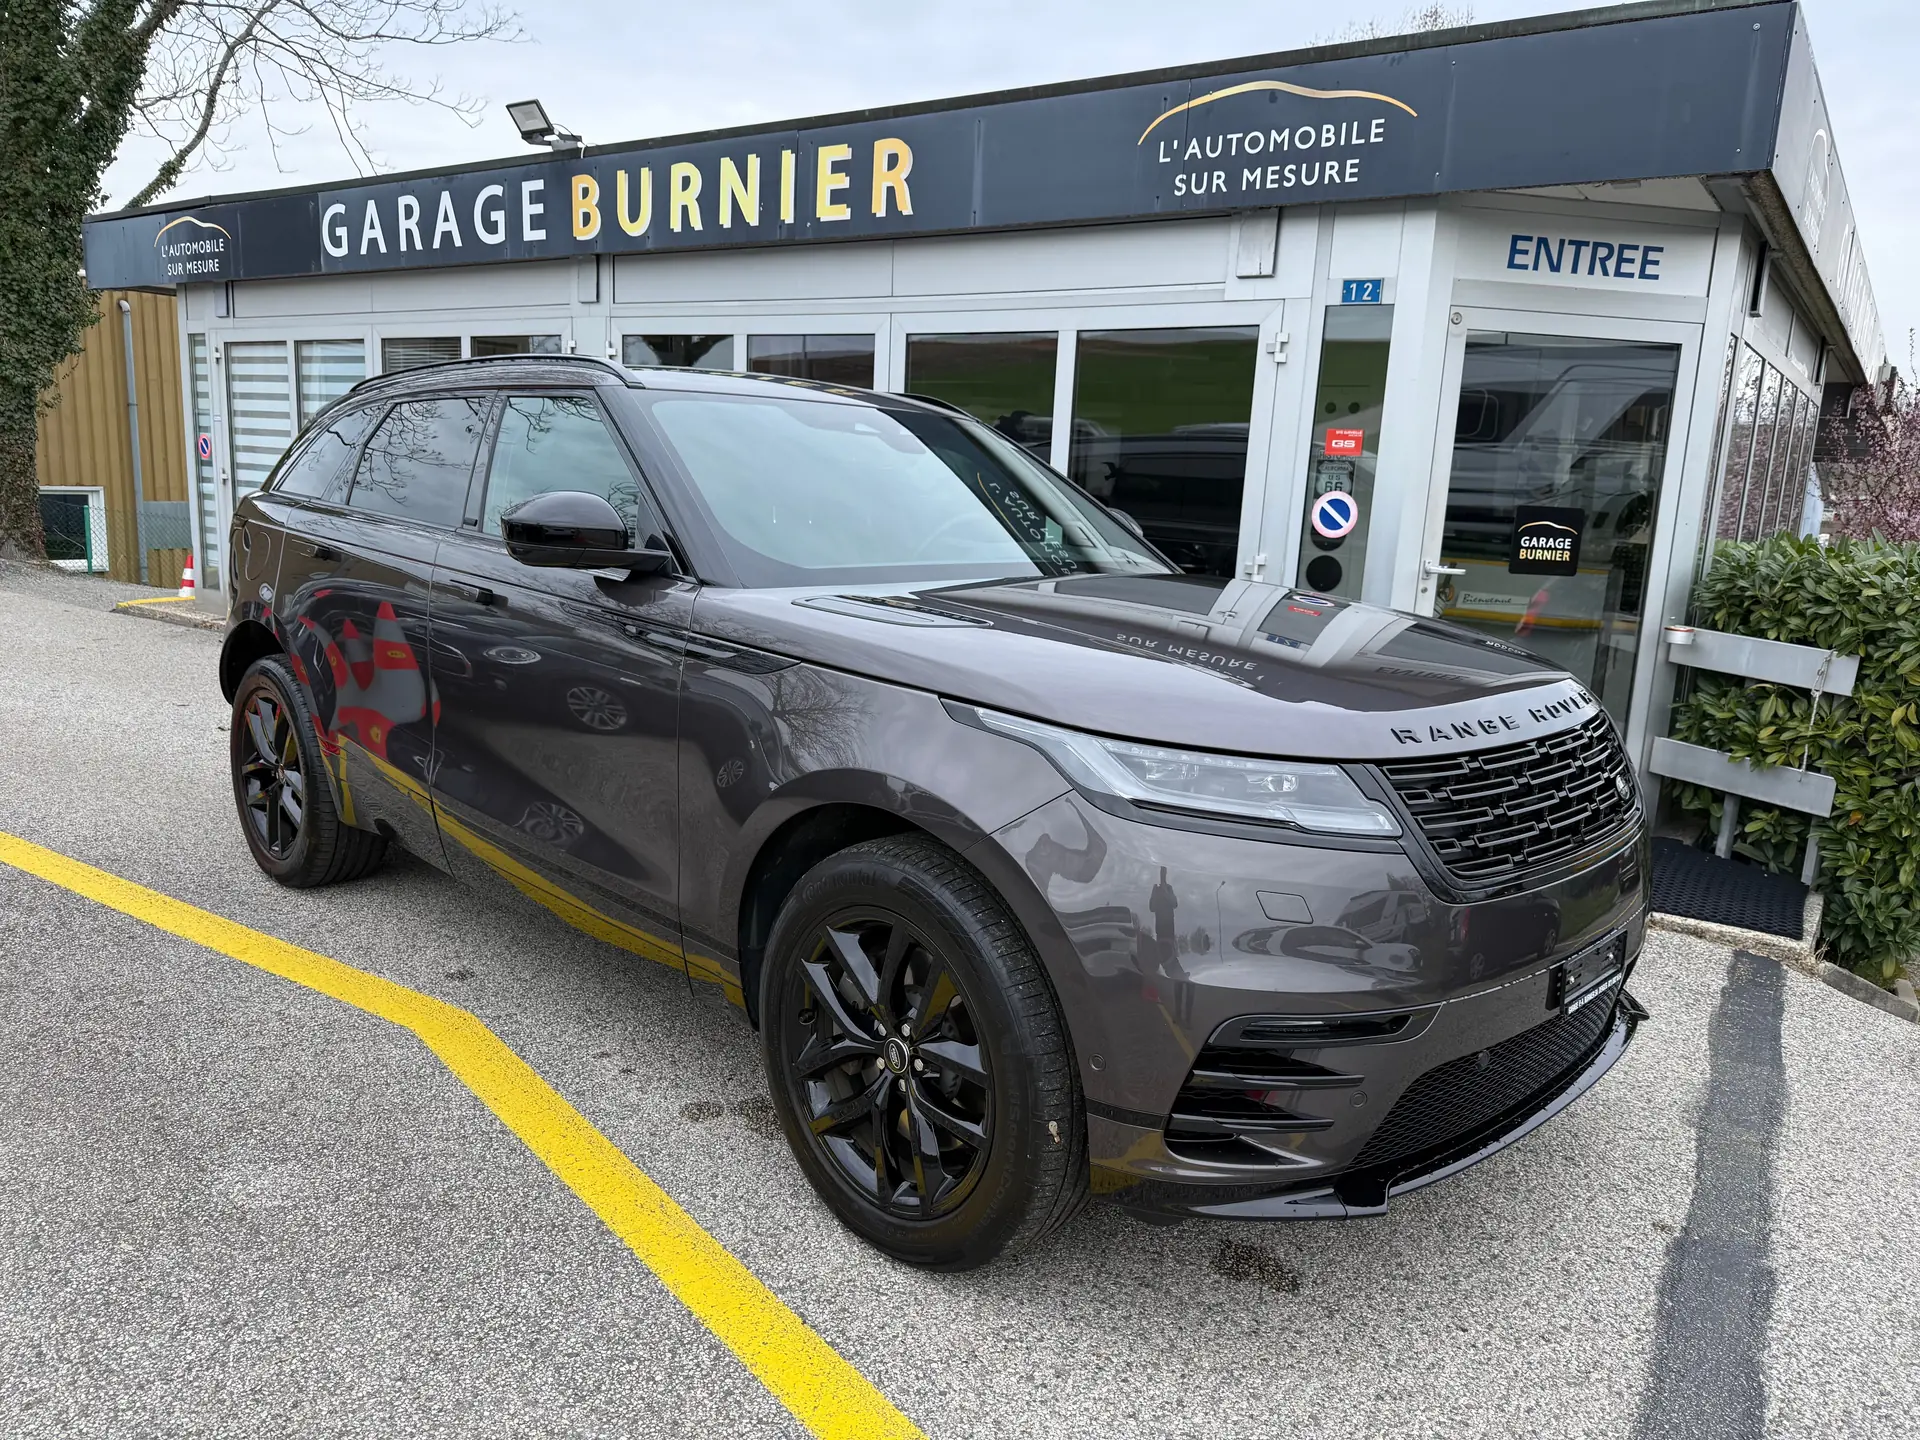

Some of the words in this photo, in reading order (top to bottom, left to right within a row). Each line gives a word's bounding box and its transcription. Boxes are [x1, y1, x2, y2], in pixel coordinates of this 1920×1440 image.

[1158, 118, 1386, 163] L'AUTOMOBILE
[1173, 170, 1228, 197] SUR
[1241, 158, 1360, 191] MESURE
[321, 179, 548, 258] GARAGE
[571, 138, 914, 241] BURNIER
[161, 238, 225, 257] L'AUTOMOBILE
[167, 262, 184, 276] SUR
[186, 258, 220, 274] MESURE
[1506, 234, 1665, 281] ENTREE
[1349, 282, 1373, 301] 12
[1331, 440, 1356, 448] GS
[1520, 536, 1572, 550] GARAGE
[1519, 549, 1571, 562] BURNIER
[1391, 715, 1520, 745] RANGE
[1528, 689, 1594, 723] ROVER
